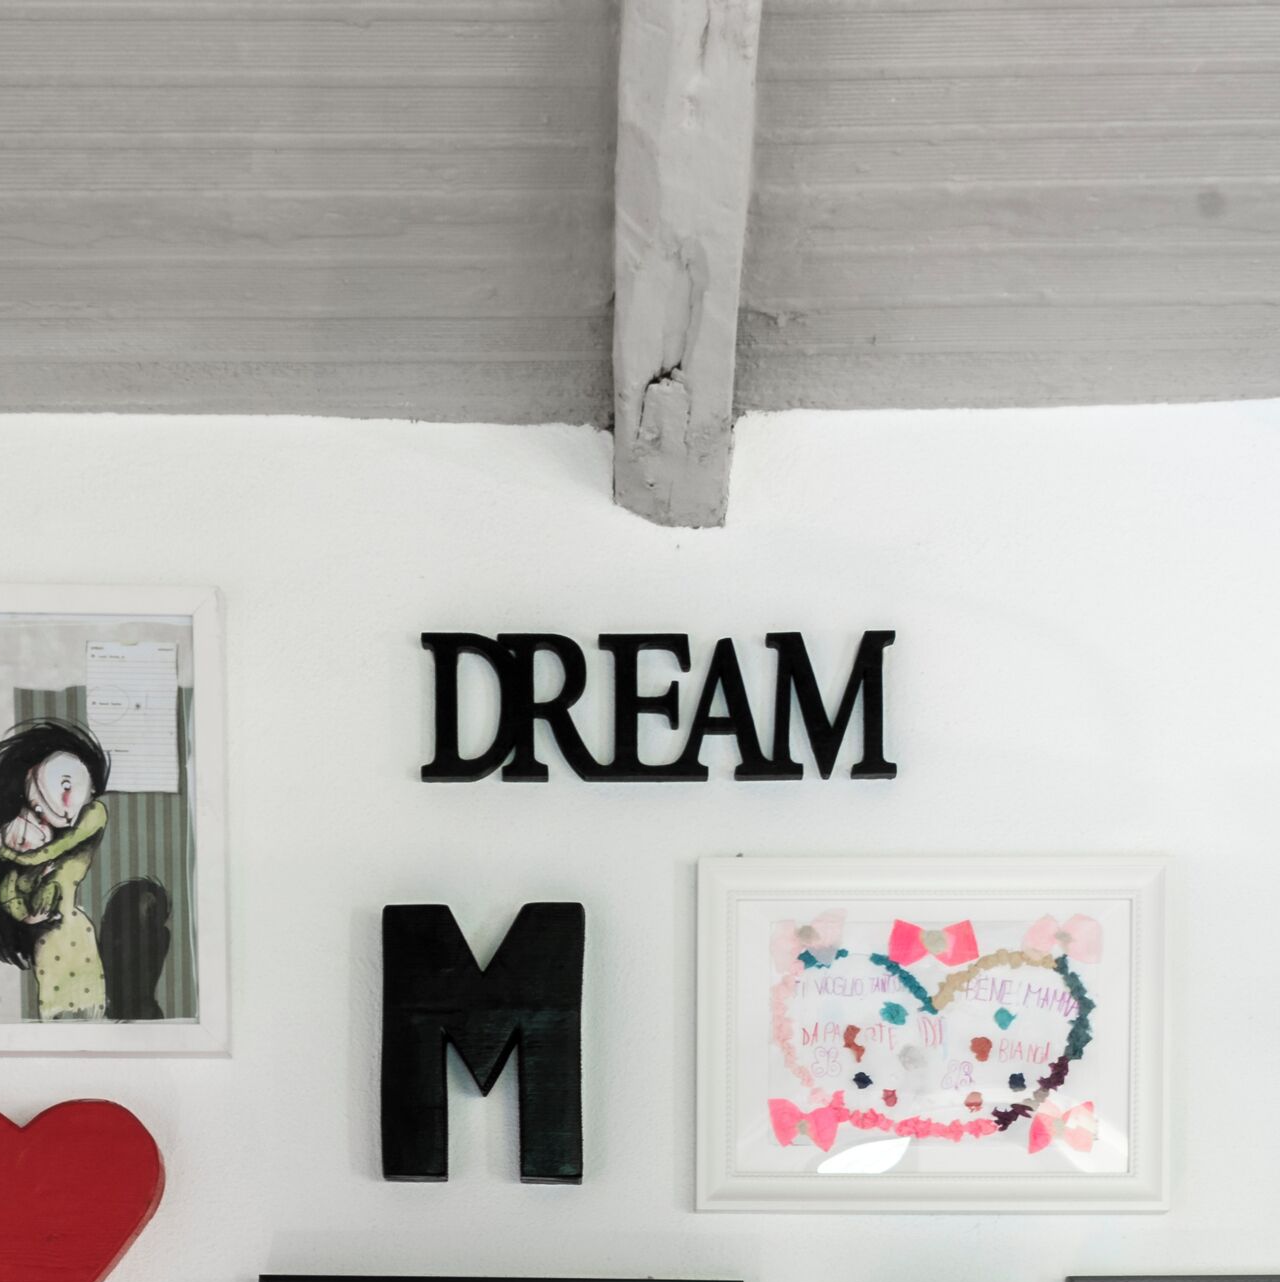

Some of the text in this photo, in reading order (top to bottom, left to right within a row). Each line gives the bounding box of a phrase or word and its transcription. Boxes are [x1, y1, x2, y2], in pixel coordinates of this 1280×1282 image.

[420, 630, 898, 783] DREAM
[381, 902, 586, 1185] M
[802, 1021, 819, 1046] DA
